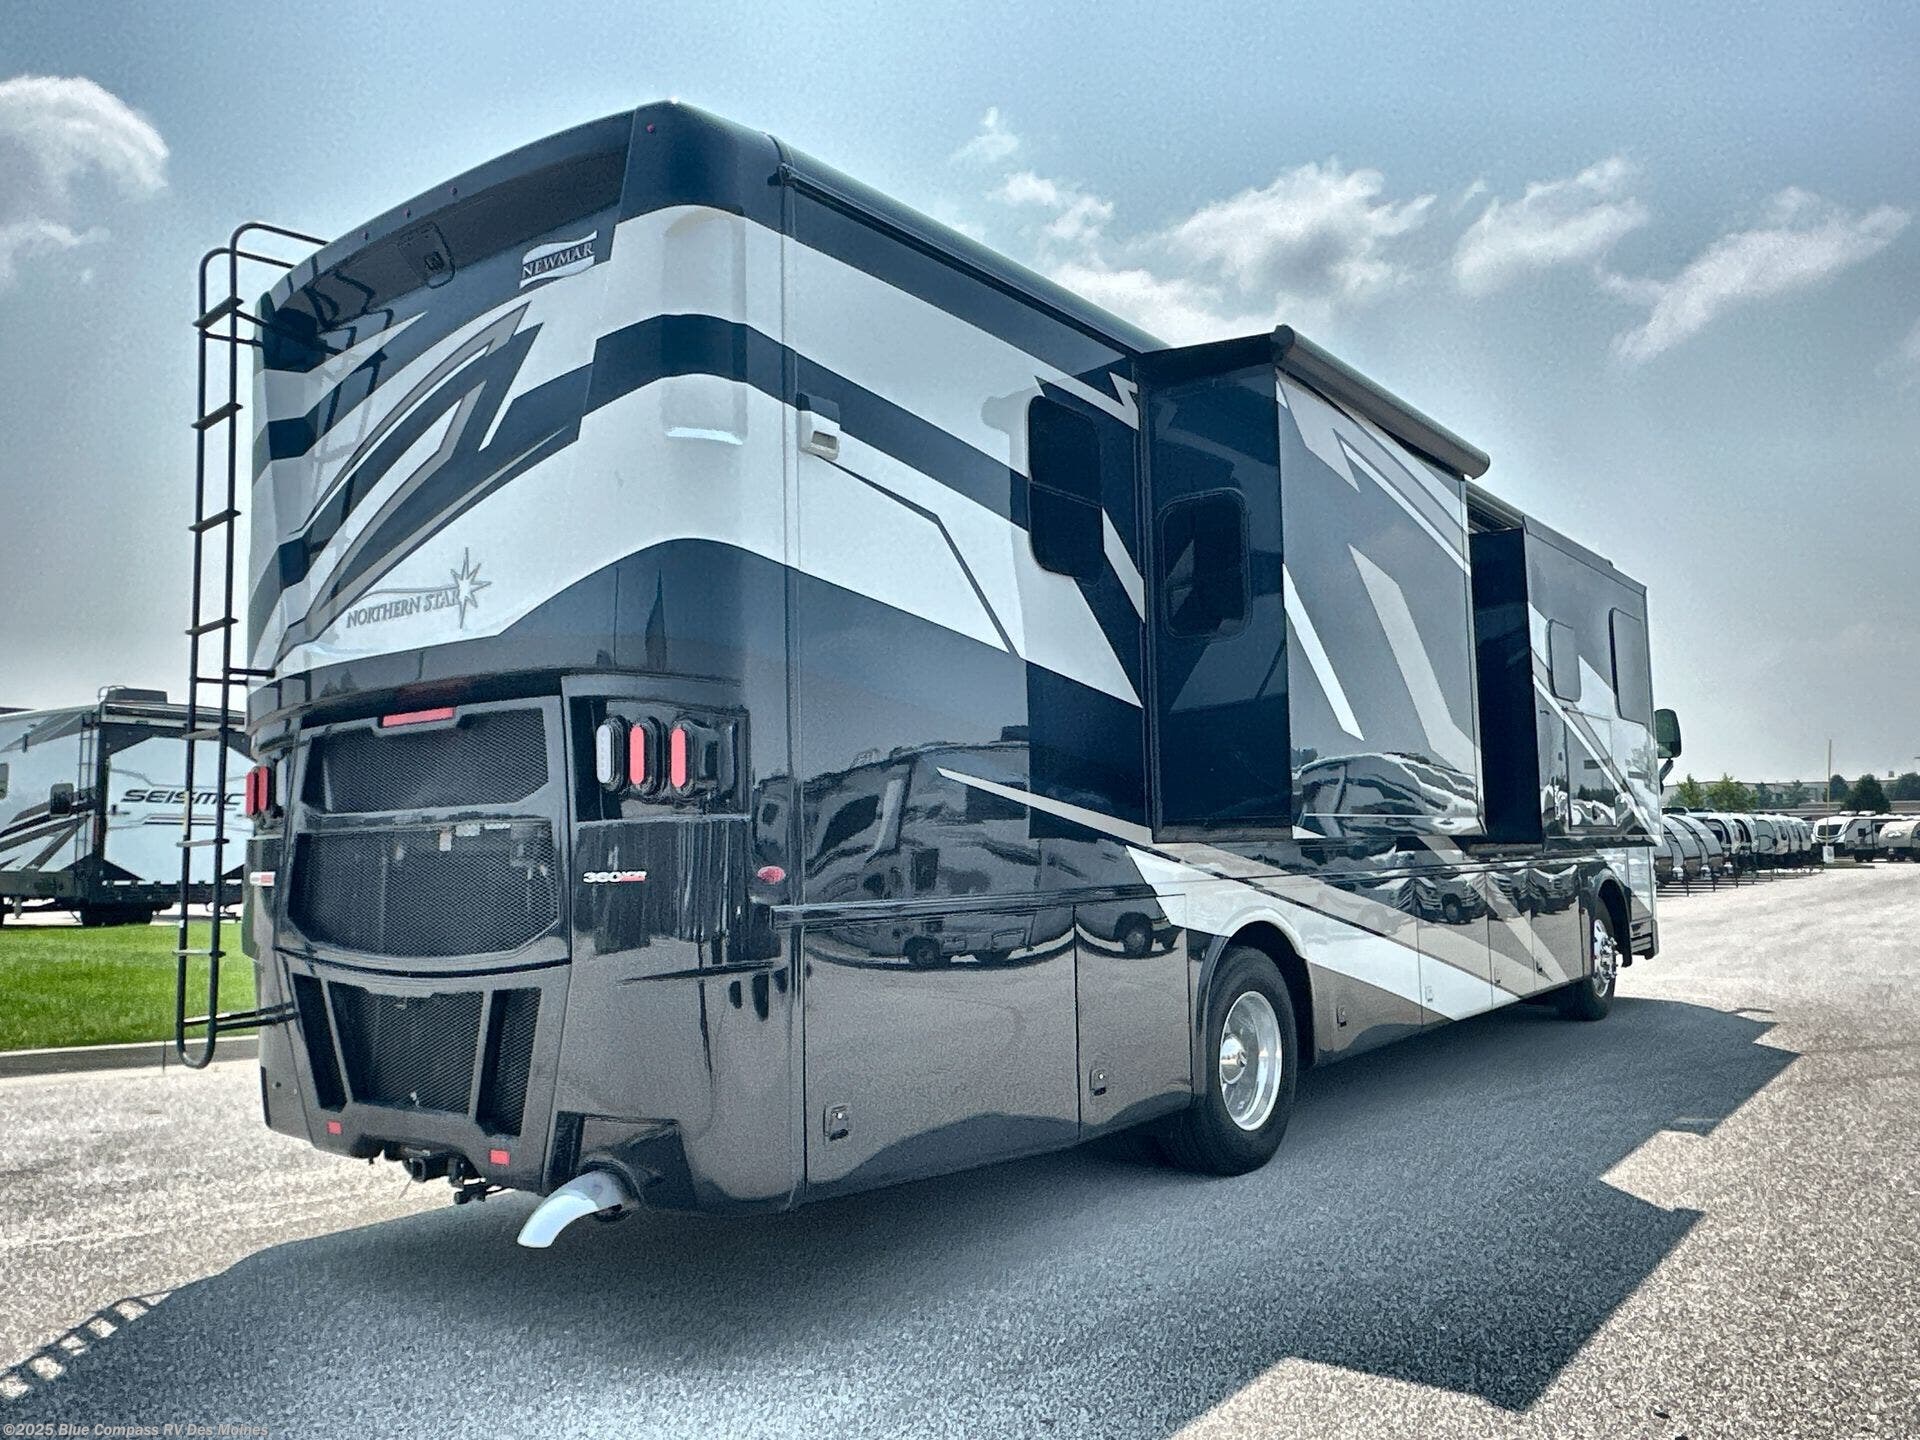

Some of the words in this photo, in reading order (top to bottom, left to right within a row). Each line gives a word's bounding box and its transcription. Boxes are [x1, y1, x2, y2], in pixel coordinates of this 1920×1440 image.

[522, 242, 595, 279] NEWMAR
[346, 596, 422, 628] NORTHERN
[120, 789, 245, 805] SEISMC
